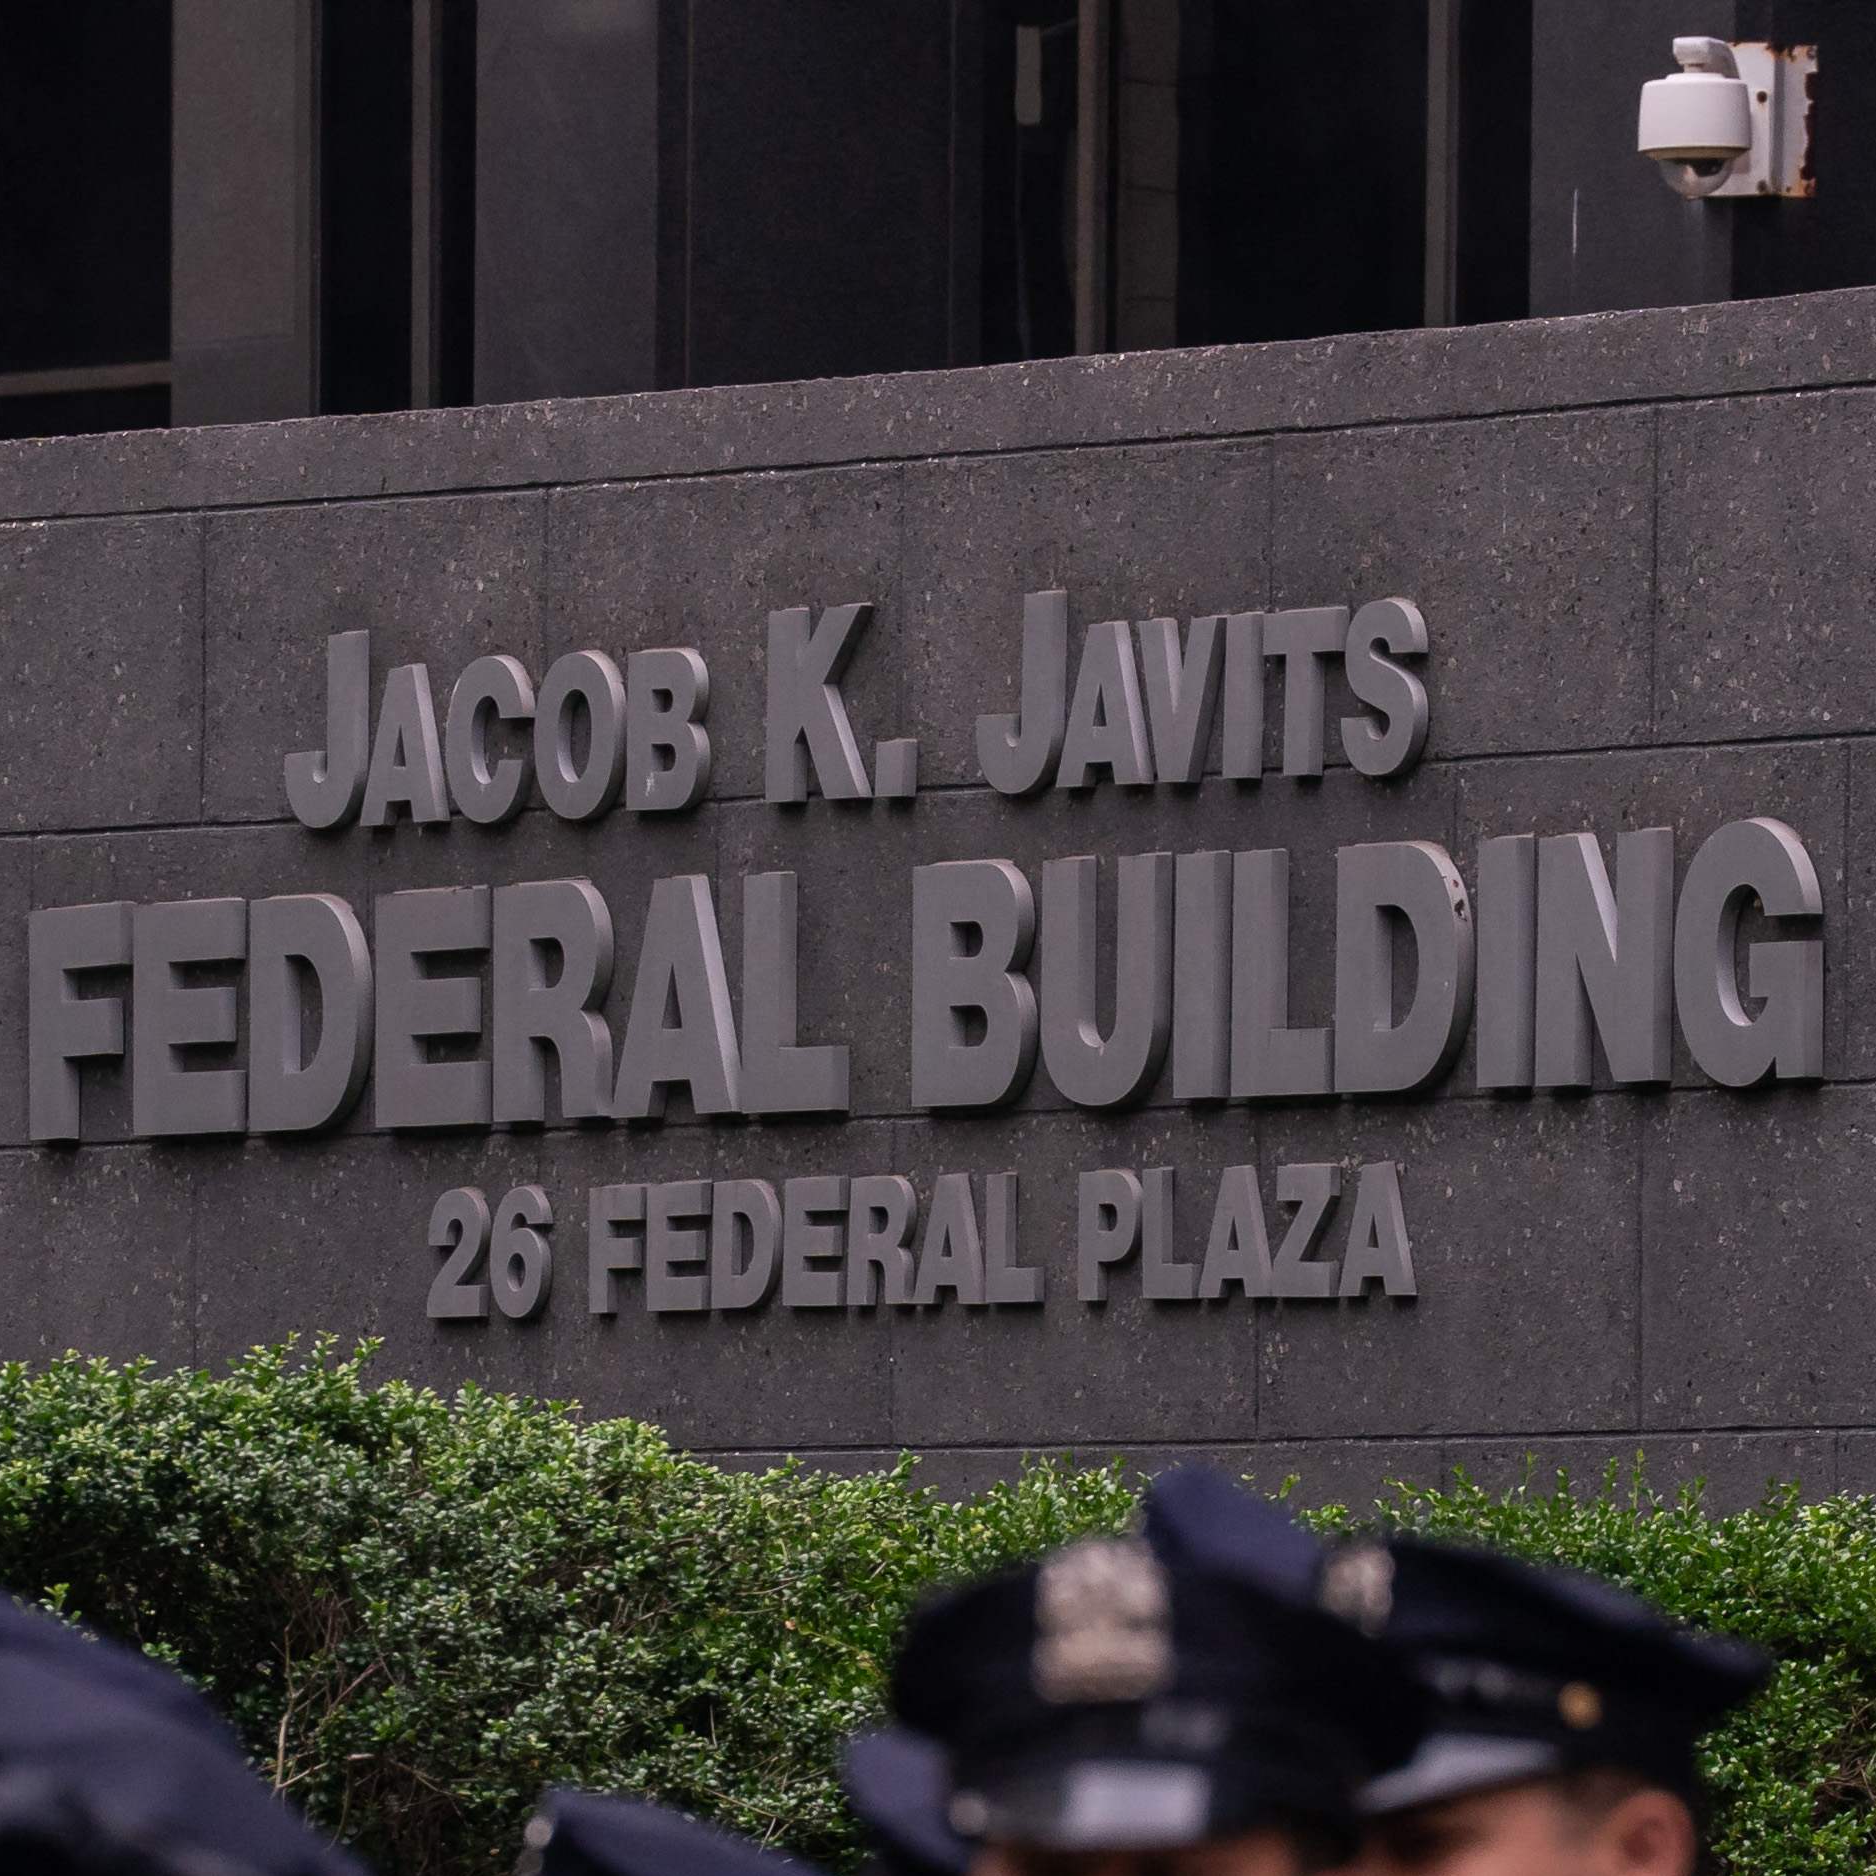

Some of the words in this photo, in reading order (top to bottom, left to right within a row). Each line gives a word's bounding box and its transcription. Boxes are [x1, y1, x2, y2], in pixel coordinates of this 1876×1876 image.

[284, 629, 711, 829] JACOB
[765, 602, 917, 802] K.
[974, 590, 1429, 796] JAVITS
[28, 870, 850, 1141] FEDERAL
[912, 816, 1824, 1108] BUILDING
[426, 1183, 554, 1319] 26
[588, 1171, 1045, 1314] FEDERAL
[1076, 1160, 1418, 1304] PLAZA
